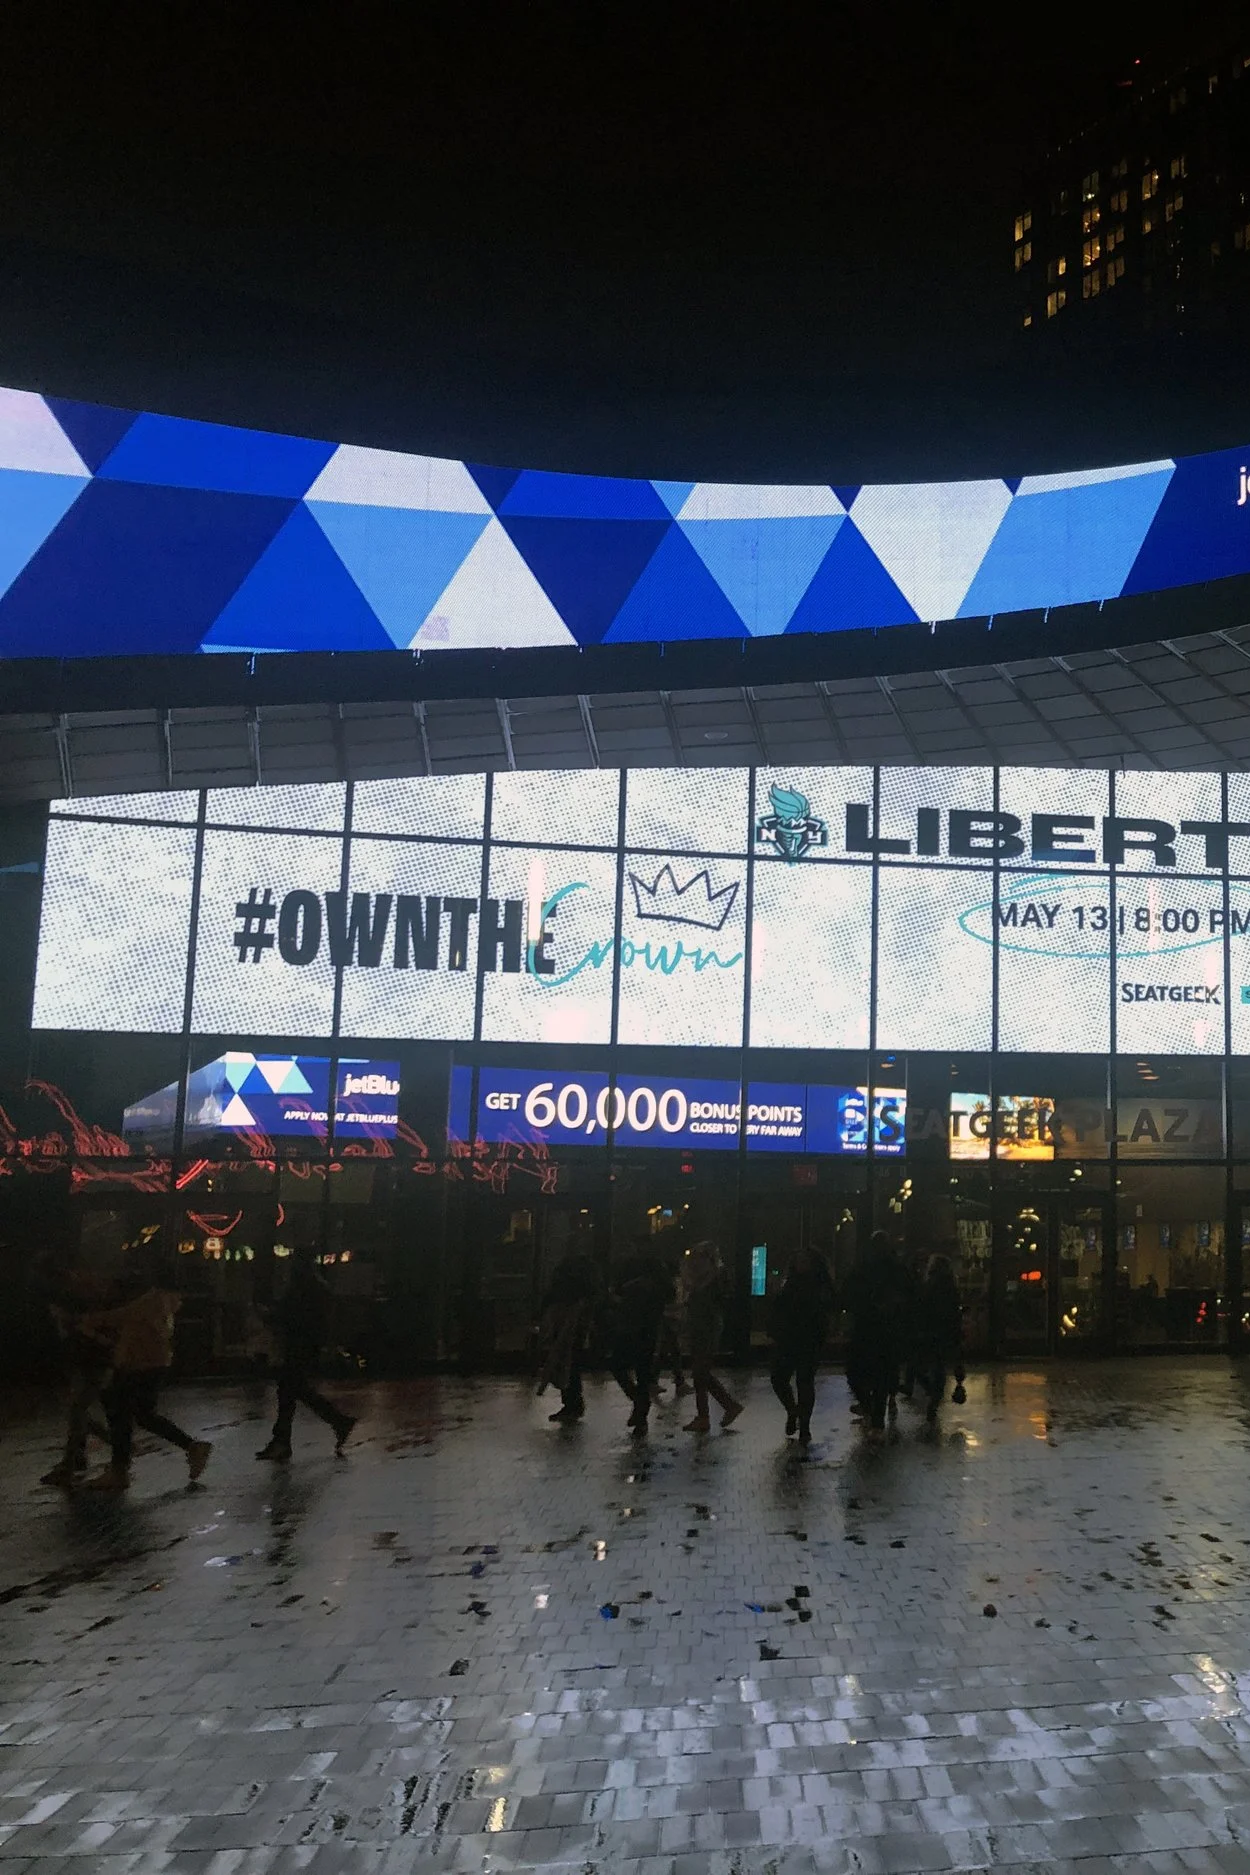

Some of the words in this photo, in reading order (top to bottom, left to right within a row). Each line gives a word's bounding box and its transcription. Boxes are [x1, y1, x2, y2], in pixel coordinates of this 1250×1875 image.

[993, 903, 1063, 930] MAY
[1073, 905, 1109, 931] 13
[1134, 906, 1200, 933] 8:00
[1121, 982, 1221, 1005] SEATGEEK
[343, 1073, 400, 1097] jetBlu
[284, 1110, 310, 1121] APPLY
[485, 1092, 521, 1111] GET
[523, 1082, 688, 1136] 60,000
[689, 1101, 742, 1120] BONUS
[747, 1104, 803, 1123] POINTS
[689, 1121, 724, 1134] CLOSER
[725, 1123, 738, 1135] TO
[760, 1125, 777, 1136] FAR
[777, 1126, 803, 1138] AWAY
